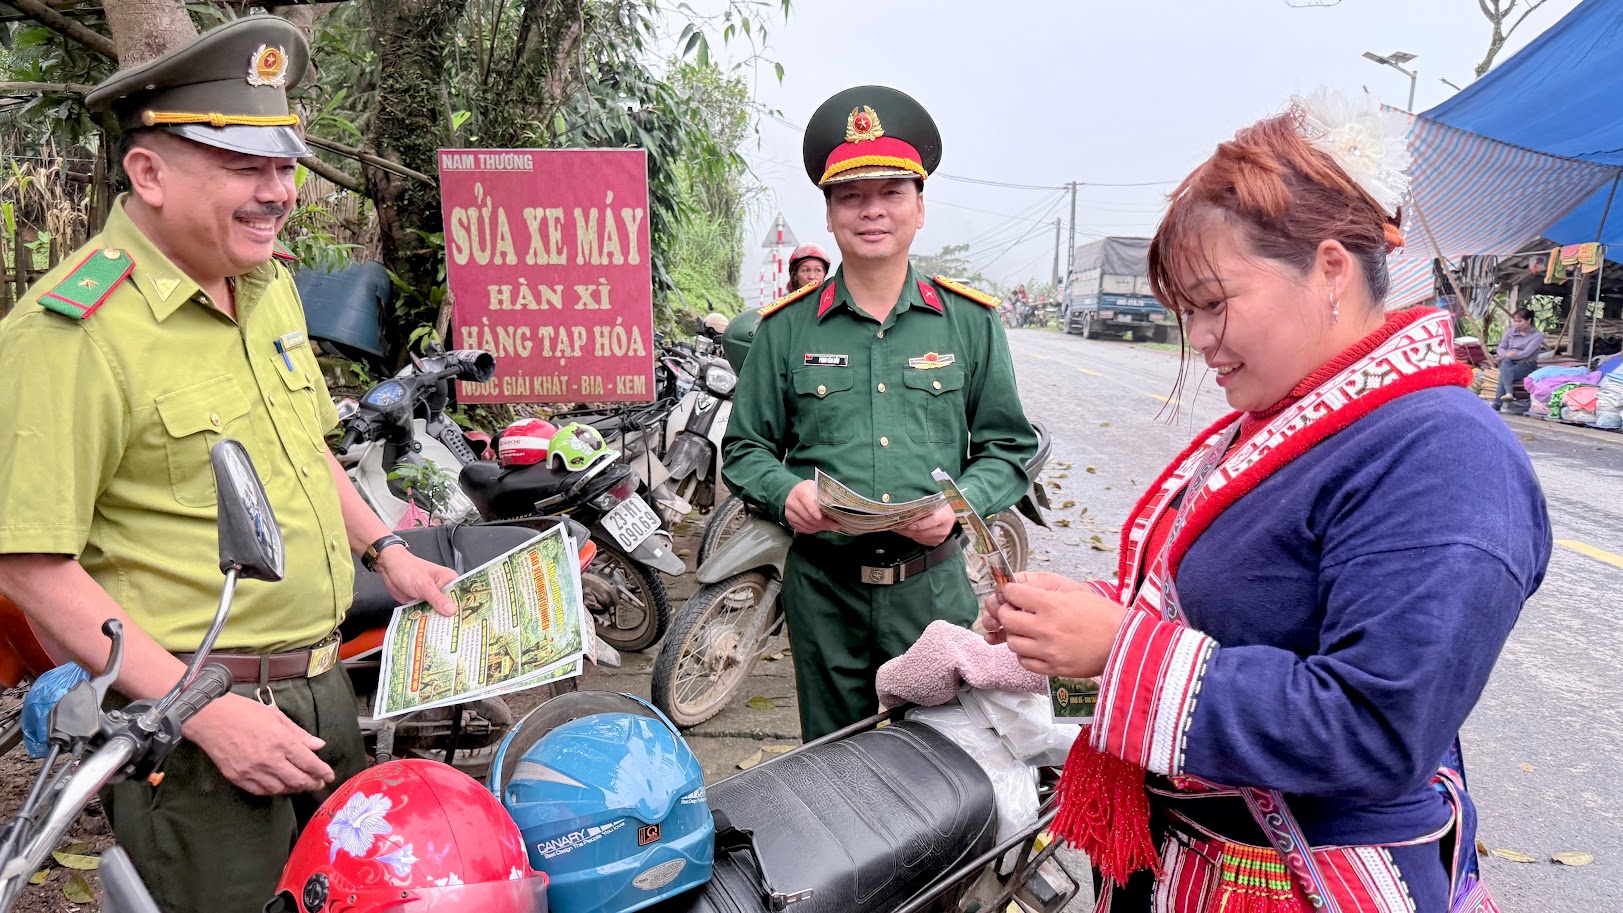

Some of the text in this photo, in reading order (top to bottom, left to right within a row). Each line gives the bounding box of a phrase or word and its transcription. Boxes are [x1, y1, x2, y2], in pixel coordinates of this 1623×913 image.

[442, 152, 534, 169] NAM THƯƠNG
[451, 182, 644, 266] SỬA XE MÁY
[487, 277, 612, 310] HÀN XÌ
[461, 316, 646, 366] HÀNG TẠP HÓA
[503, 369, 531, 396] GIẢI
[533, 371, 568, 395] KHÁT
[581, 375, 604, 395] BIA
[616, 375, 646, 395] KEM
[619, 511, 657, 547] 090.69
[537, 829, 585, 854] CANARY
